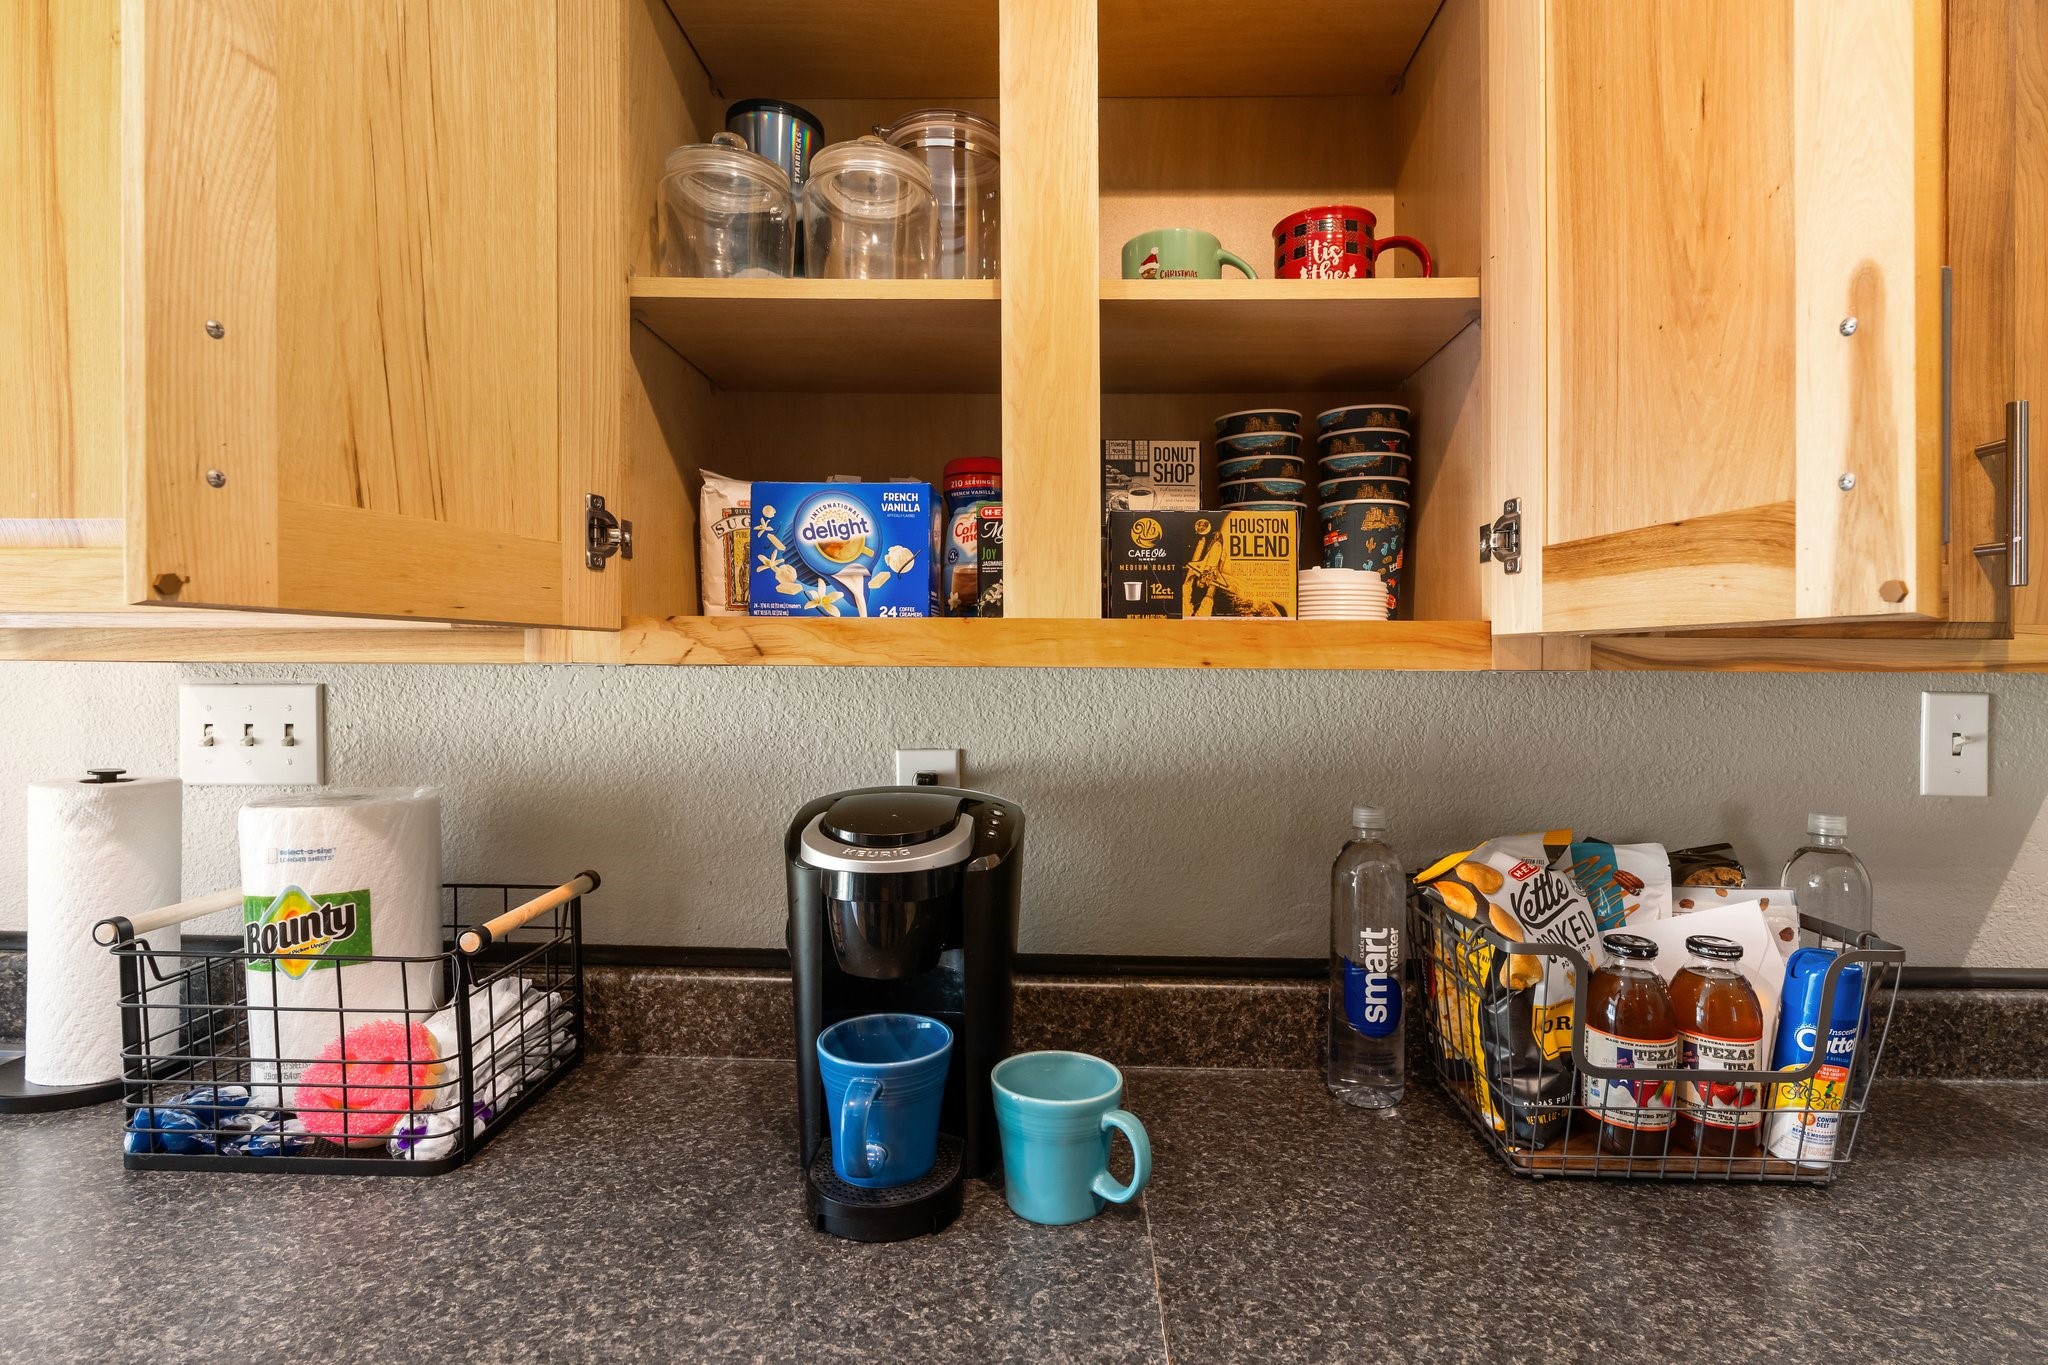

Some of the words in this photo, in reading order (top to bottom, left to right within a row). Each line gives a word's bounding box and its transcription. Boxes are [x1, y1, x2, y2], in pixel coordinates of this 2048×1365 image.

[794, 132, 802, 183] STARBUCKS
[1160, 269, 1198, 279] CHRISTMAS
[1154, 447, 1196, 462] DONUT
[1153, 463, 1195, 483] SHOP
[951, 480, 963, 488] 210
[883, 492, 919, 502] FRENCH
[810, 502, 860, 520] INTERNATIONAL
[881, 503, 920, 512] VANILLA
[802, 517, 869, 540] delight
[1230, 518, 1288, 534] HOUSTON
[982, 546, 997, 560] JOY
[1128, 549, 1151, 557] CAFE
[1230, 535, 1289, 557] BLEND
[1150, 583, 1174, 594] 12ct.
[880, 605, 897, 617] 24
[842, 848, 910, 857] KEURIG
[1510, 870, 1569, 933] Kettle
[246, 902, 357, 963] Bounty
[291, 946, 310, 955] Picker
[310, 940, 329, 949] Upper
[1389, 928, 1399, 970] water
[1360, 927, 1388, 1023] smart
[1699, 1044, 1755, 1060] TEXAS
[1724, 1062, 1755, 1070] TEA
[1523, 1099, 1553, 1110] PAPAS
